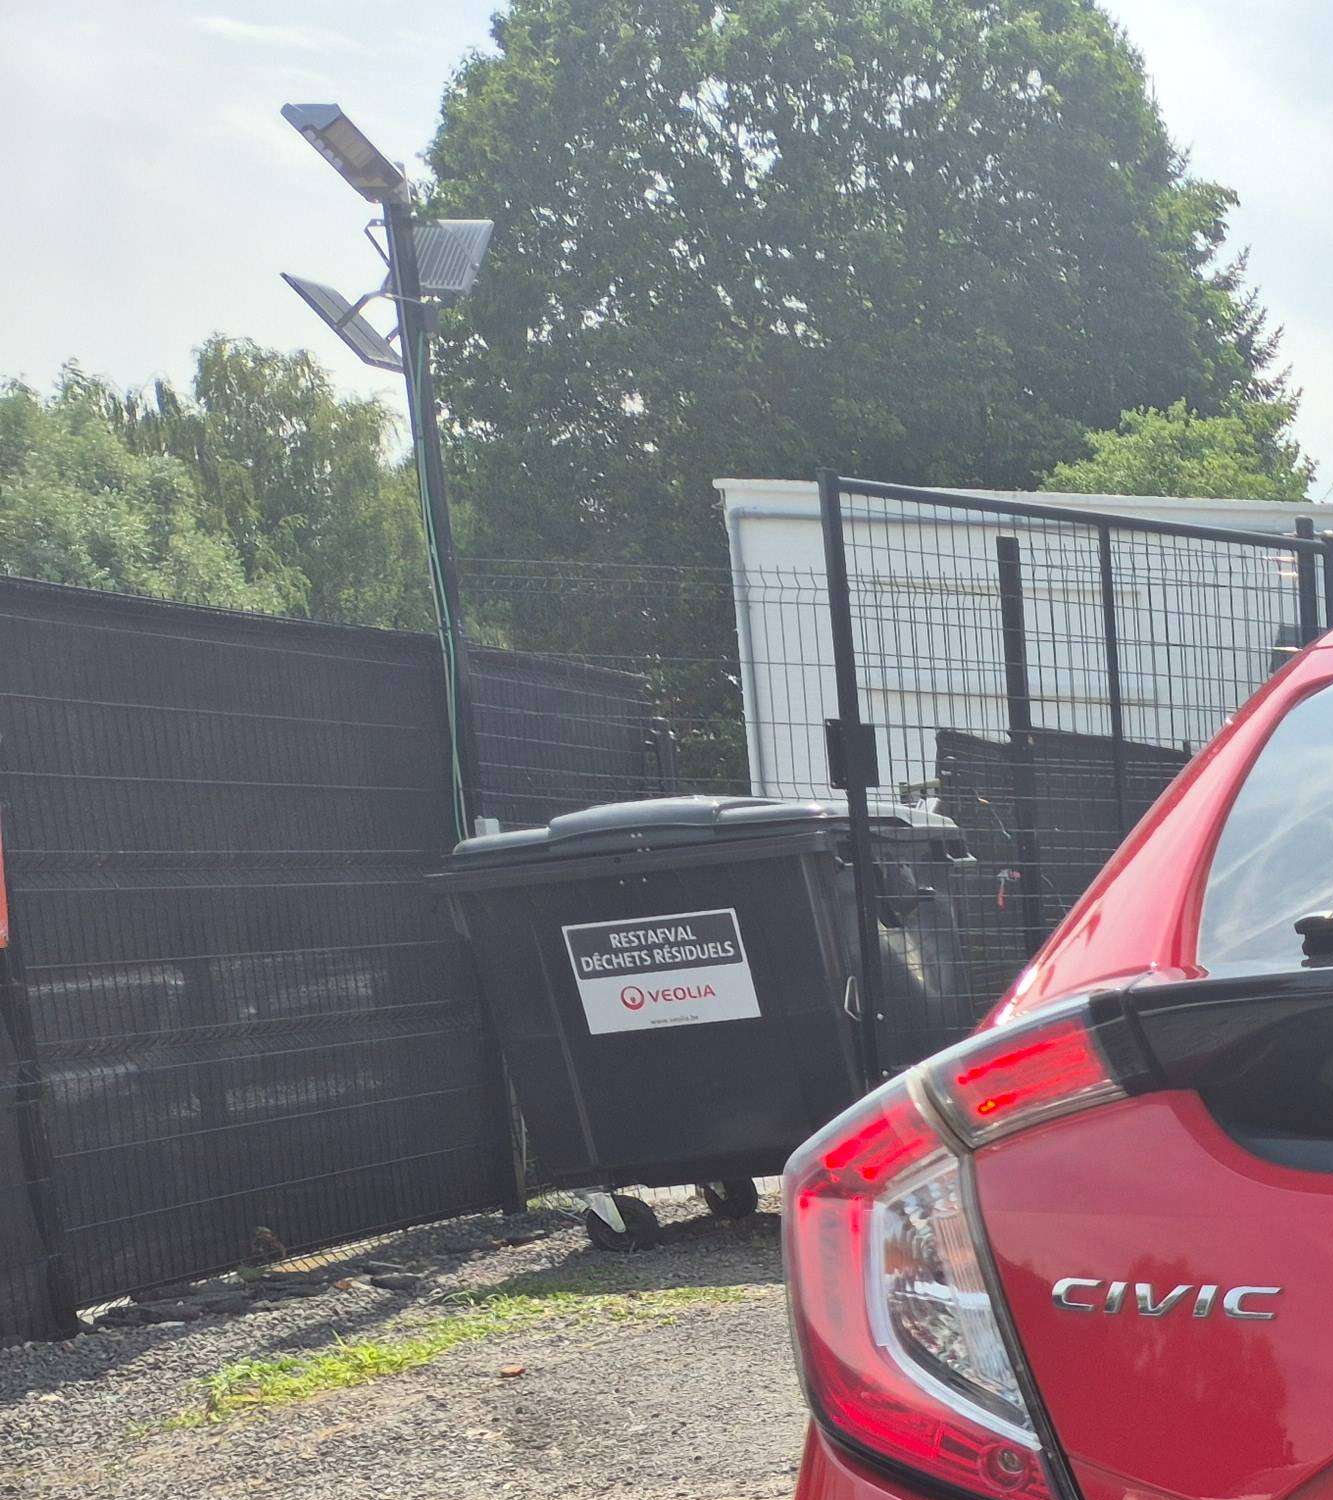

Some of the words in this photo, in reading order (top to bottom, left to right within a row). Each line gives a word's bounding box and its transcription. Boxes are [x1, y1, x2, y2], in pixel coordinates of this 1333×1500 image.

[609, 925, 697, 949] RESTAFVAL
[654, 941, 735, 965] RÉSIDUELS
[647, 984, 716, 1004] VEOLIA
[1051, 1277, 1282, 1320] CIVIC
